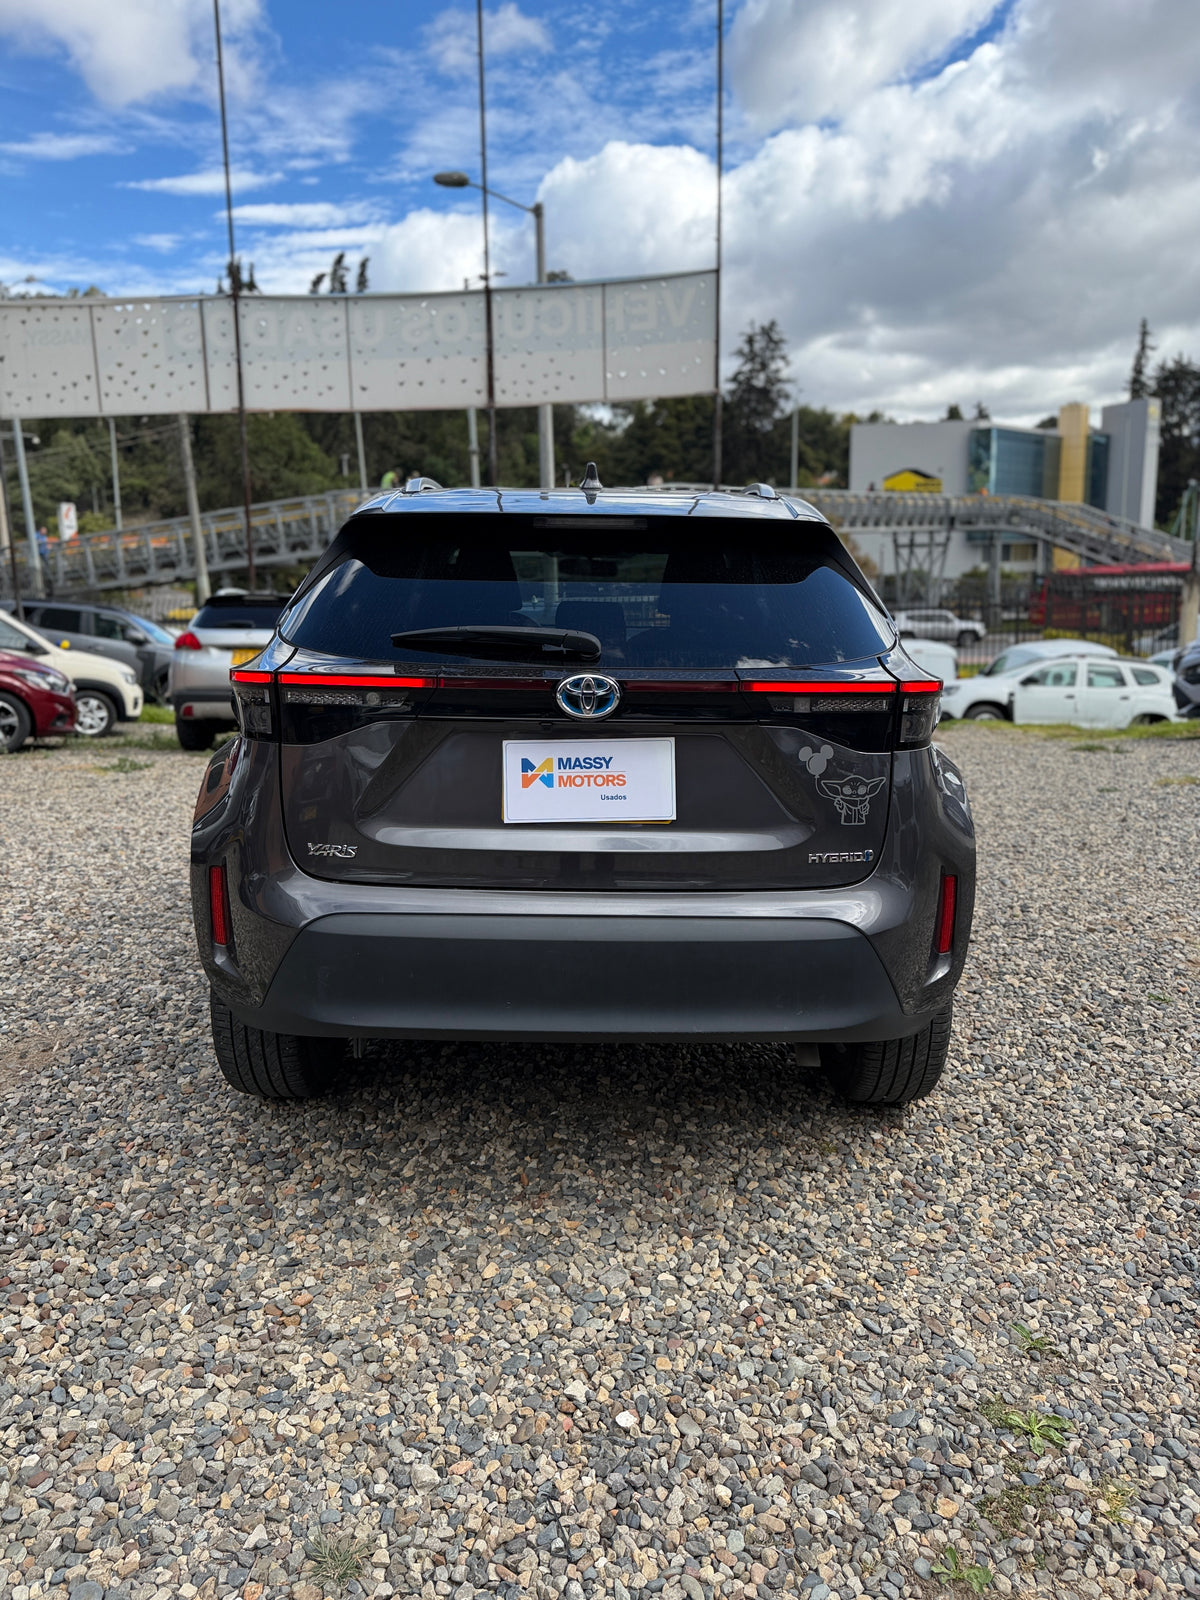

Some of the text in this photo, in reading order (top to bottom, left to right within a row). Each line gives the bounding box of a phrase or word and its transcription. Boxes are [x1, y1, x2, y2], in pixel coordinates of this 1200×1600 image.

[557, 756, 613, 770] MASSY
[558, 774, 627, 787] MOTORS
[808, 852, 863, 863] HYBRID
